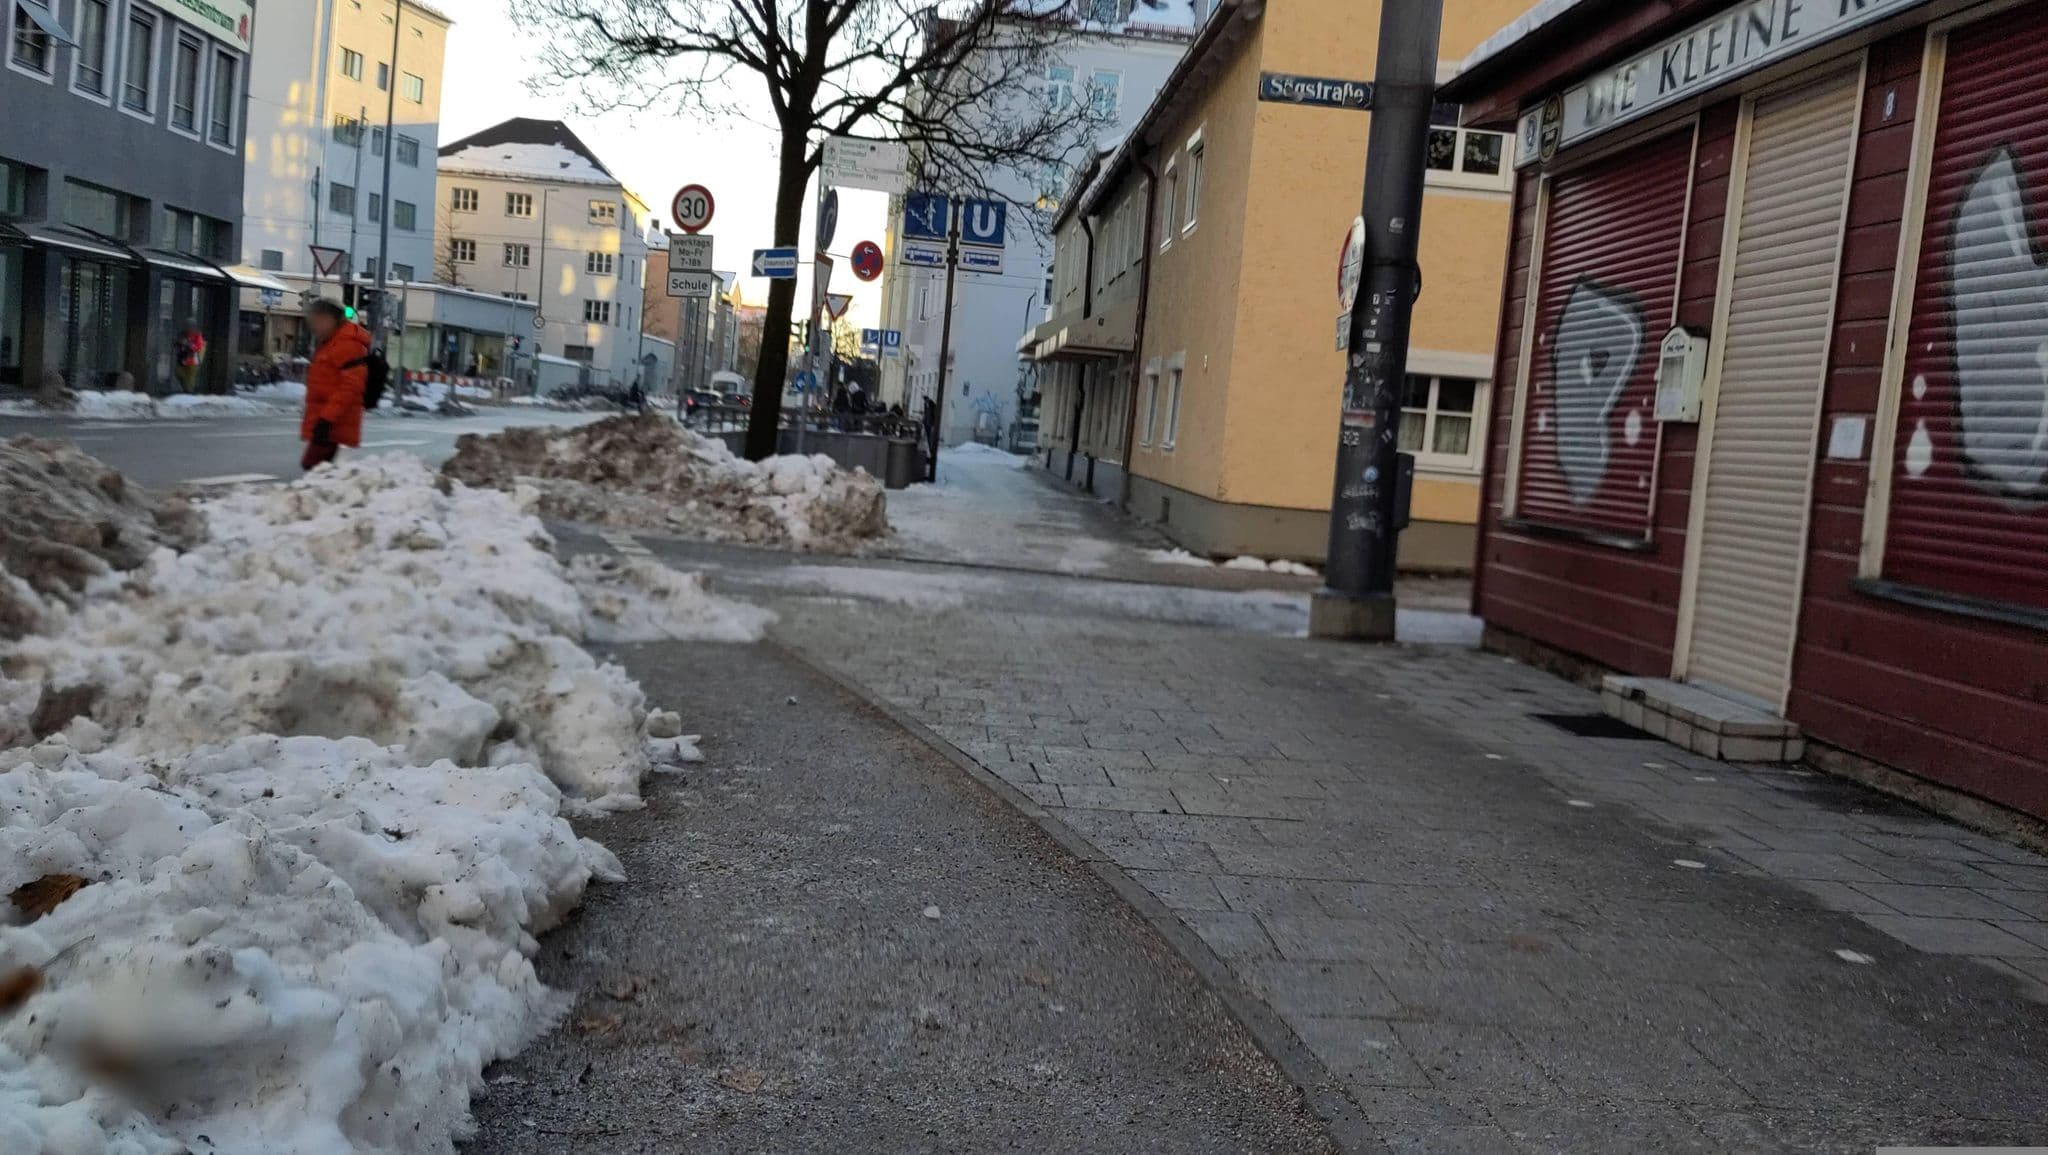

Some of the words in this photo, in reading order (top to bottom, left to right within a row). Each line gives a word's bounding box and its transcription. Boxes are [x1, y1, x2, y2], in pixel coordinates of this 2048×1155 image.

[1658, 0, 1799, 95] KLEINE
[680, 197, 706, 219] 30
[972, 204, 997, 238] U
[673, 239, 711, 249] werktags
[671, 278, 708, 290] Schule
[887, 332, 898, 345] U
